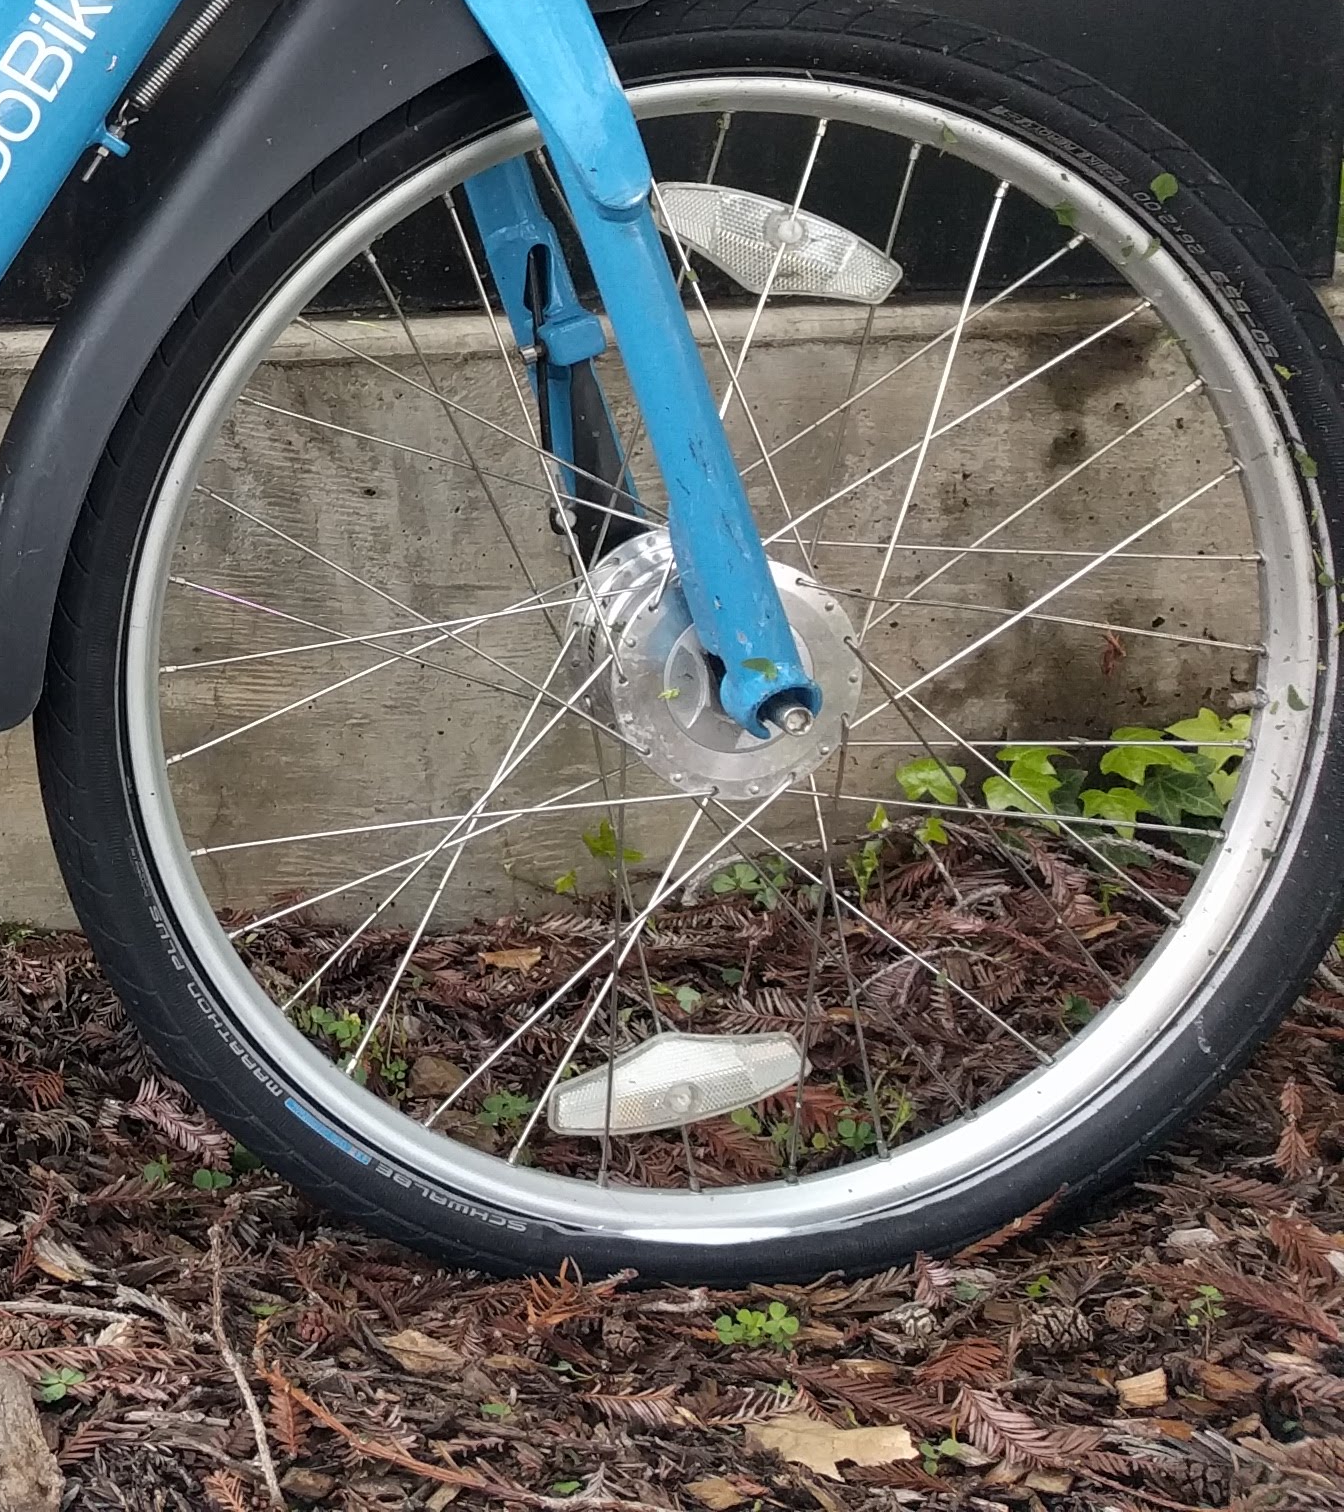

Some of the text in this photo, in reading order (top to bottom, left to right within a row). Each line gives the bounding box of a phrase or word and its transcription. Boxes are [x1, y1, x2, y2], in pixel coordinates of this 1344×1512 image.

[148, 904, 284, 1099] MARATHON PLUS
[374, 1160, 529, 1234] SCHWALBE
